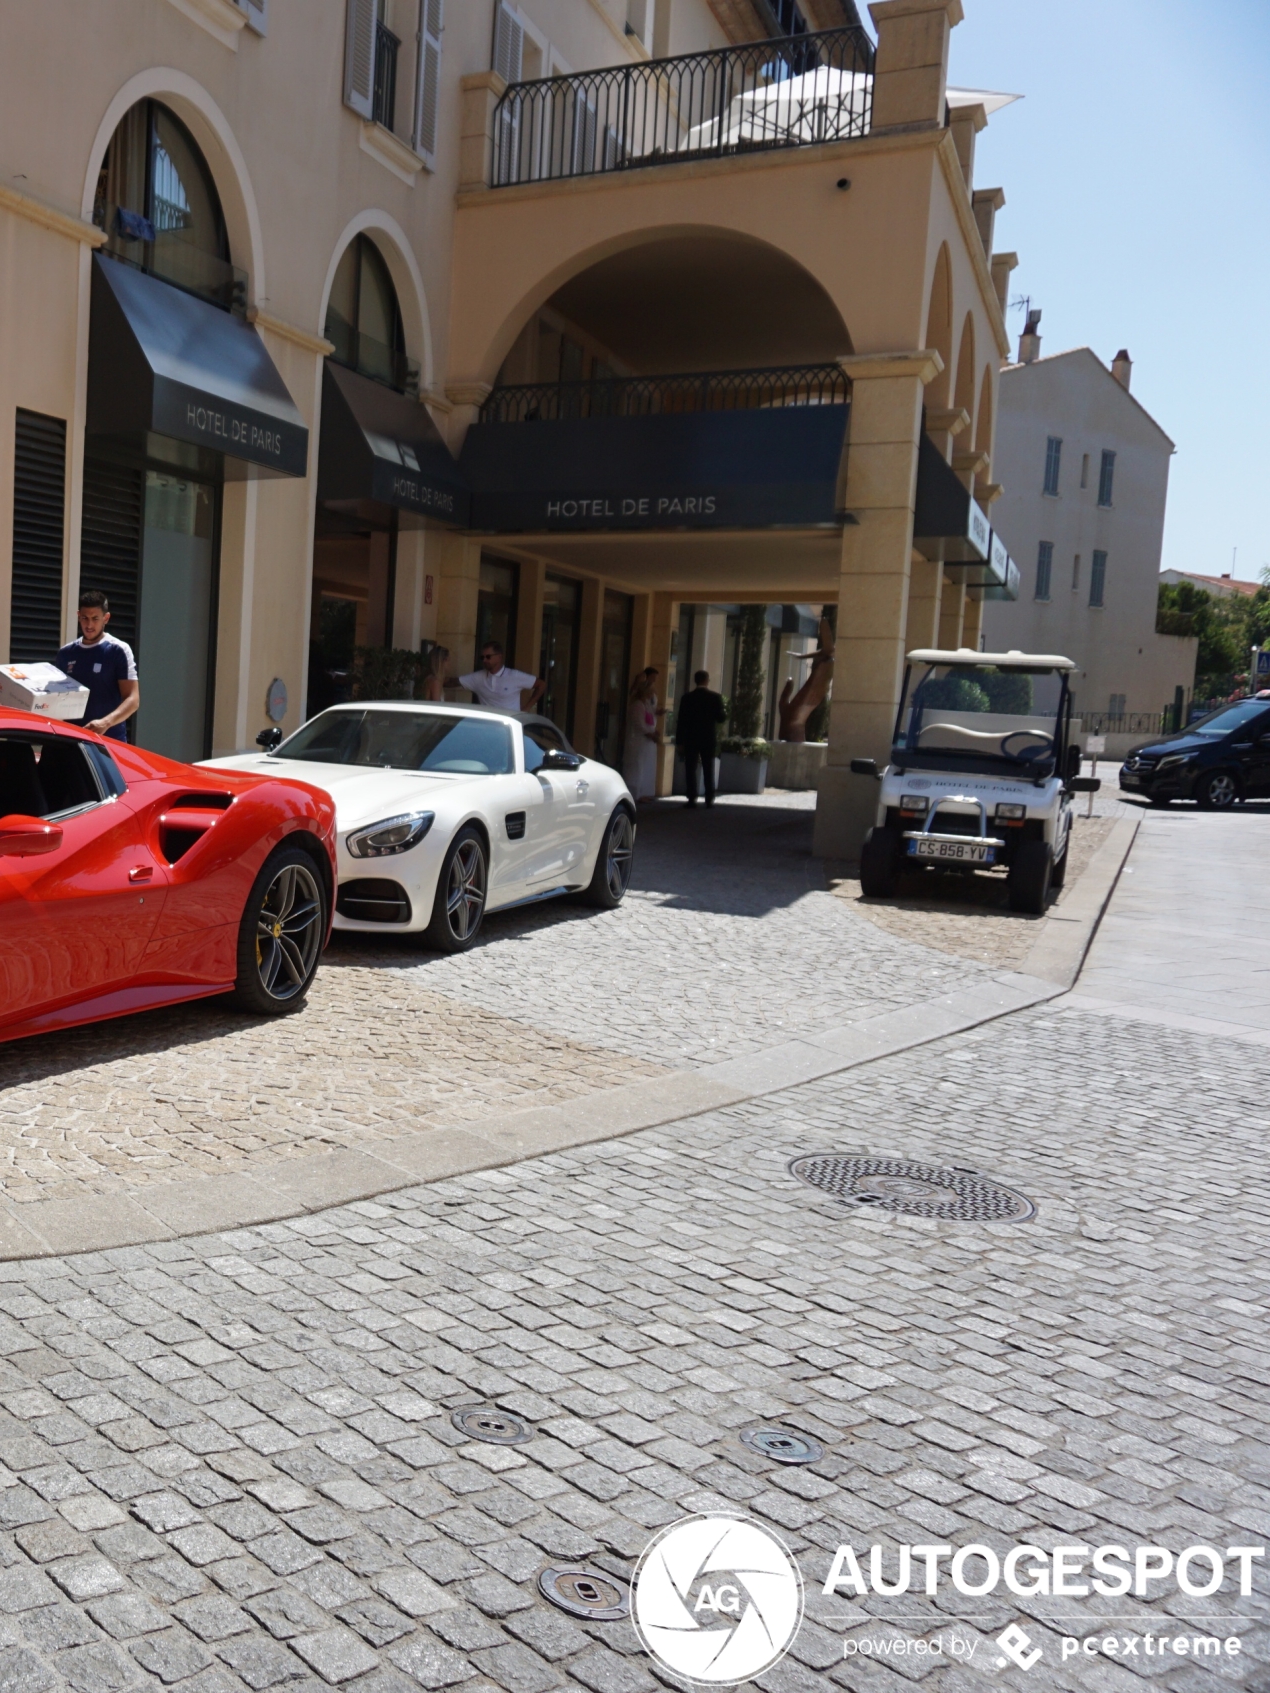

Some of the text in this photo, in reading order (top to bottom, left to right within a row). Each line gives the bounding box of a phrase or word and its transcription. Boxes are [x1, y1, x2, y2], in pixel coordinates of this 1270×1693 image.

[187, 403, 281, 455] HOTEL DE PARIS
[393, 477, 454, 512] HOTEL DE PARIS
[547, 496, 716, 517] HOTEL DE PARIS
[935, 781, 971, 789] HOTEL
[918, 842, 987, 861] CS-858-YV
